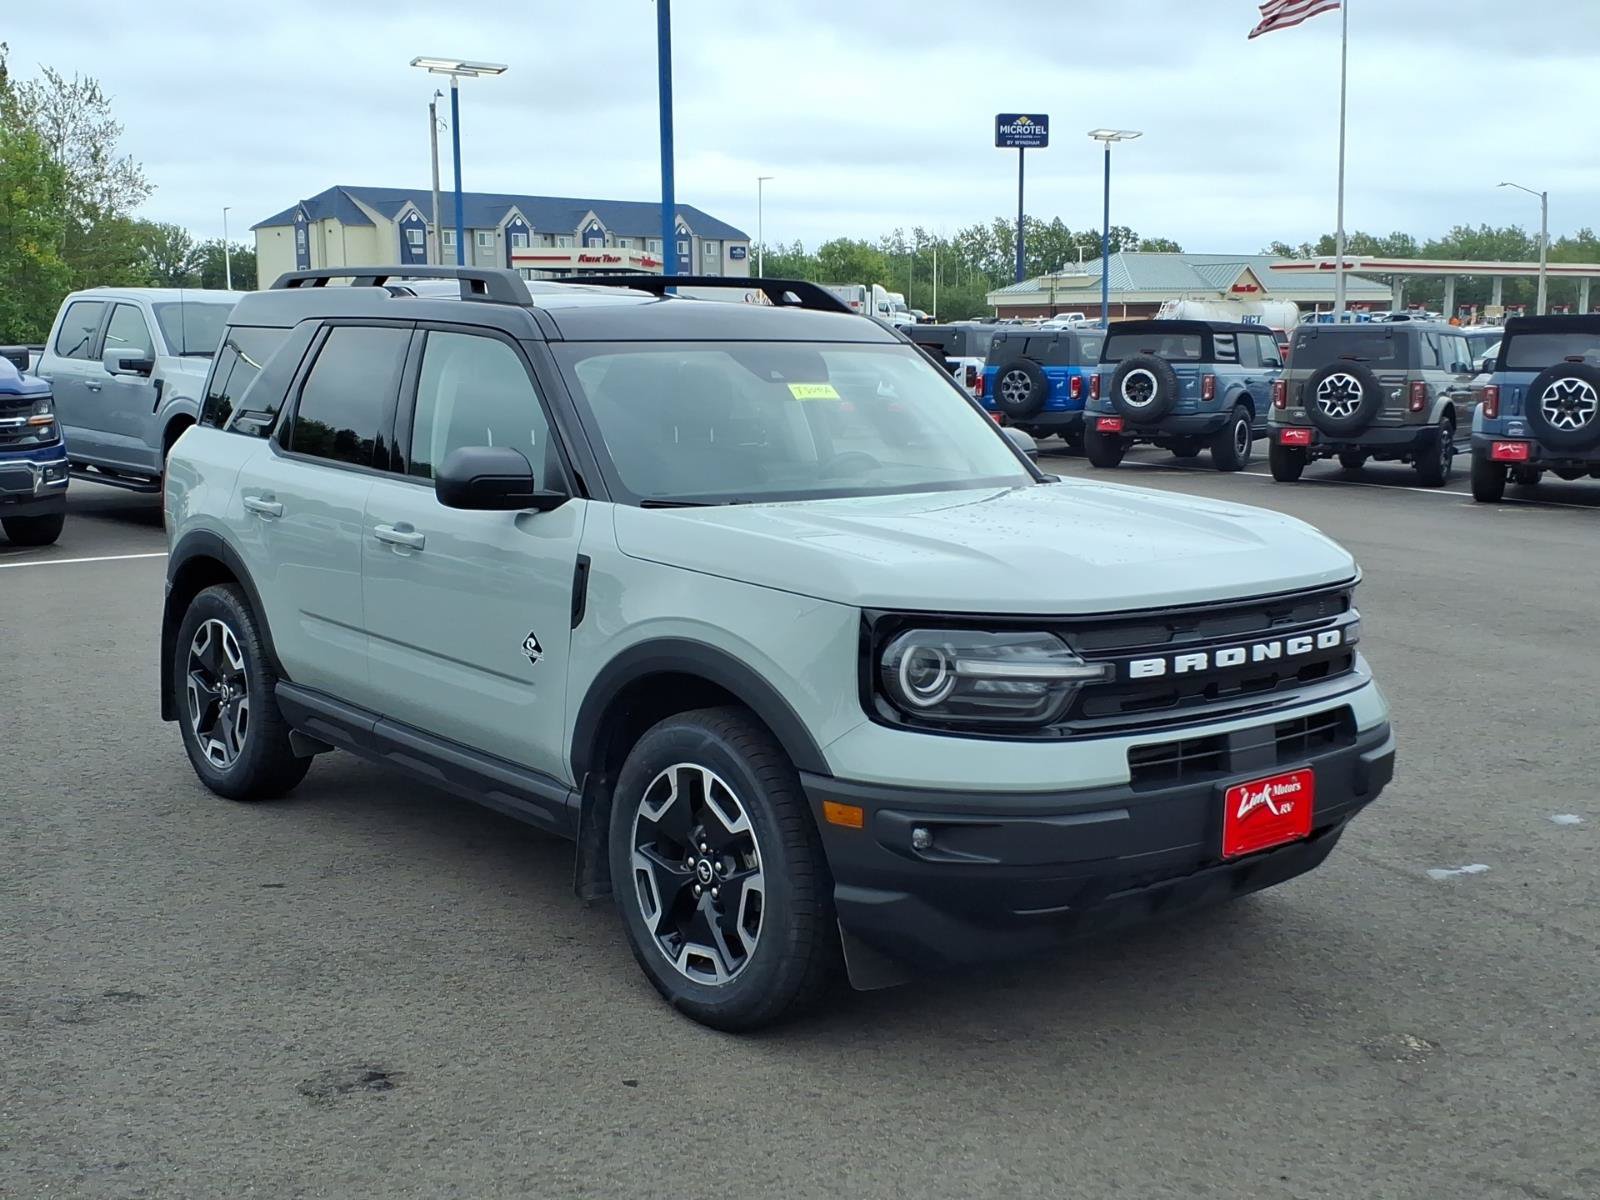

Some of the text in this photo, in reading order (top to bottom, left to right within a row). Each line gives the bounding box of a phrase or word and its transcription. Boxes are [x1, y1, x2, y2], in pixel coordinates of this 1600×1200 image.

[1000, 125, 1046, 134] MICROTEL
[1129, 629, 1342, 679] BRONCO
[1237, 782, 1302, 819] Link Motors
